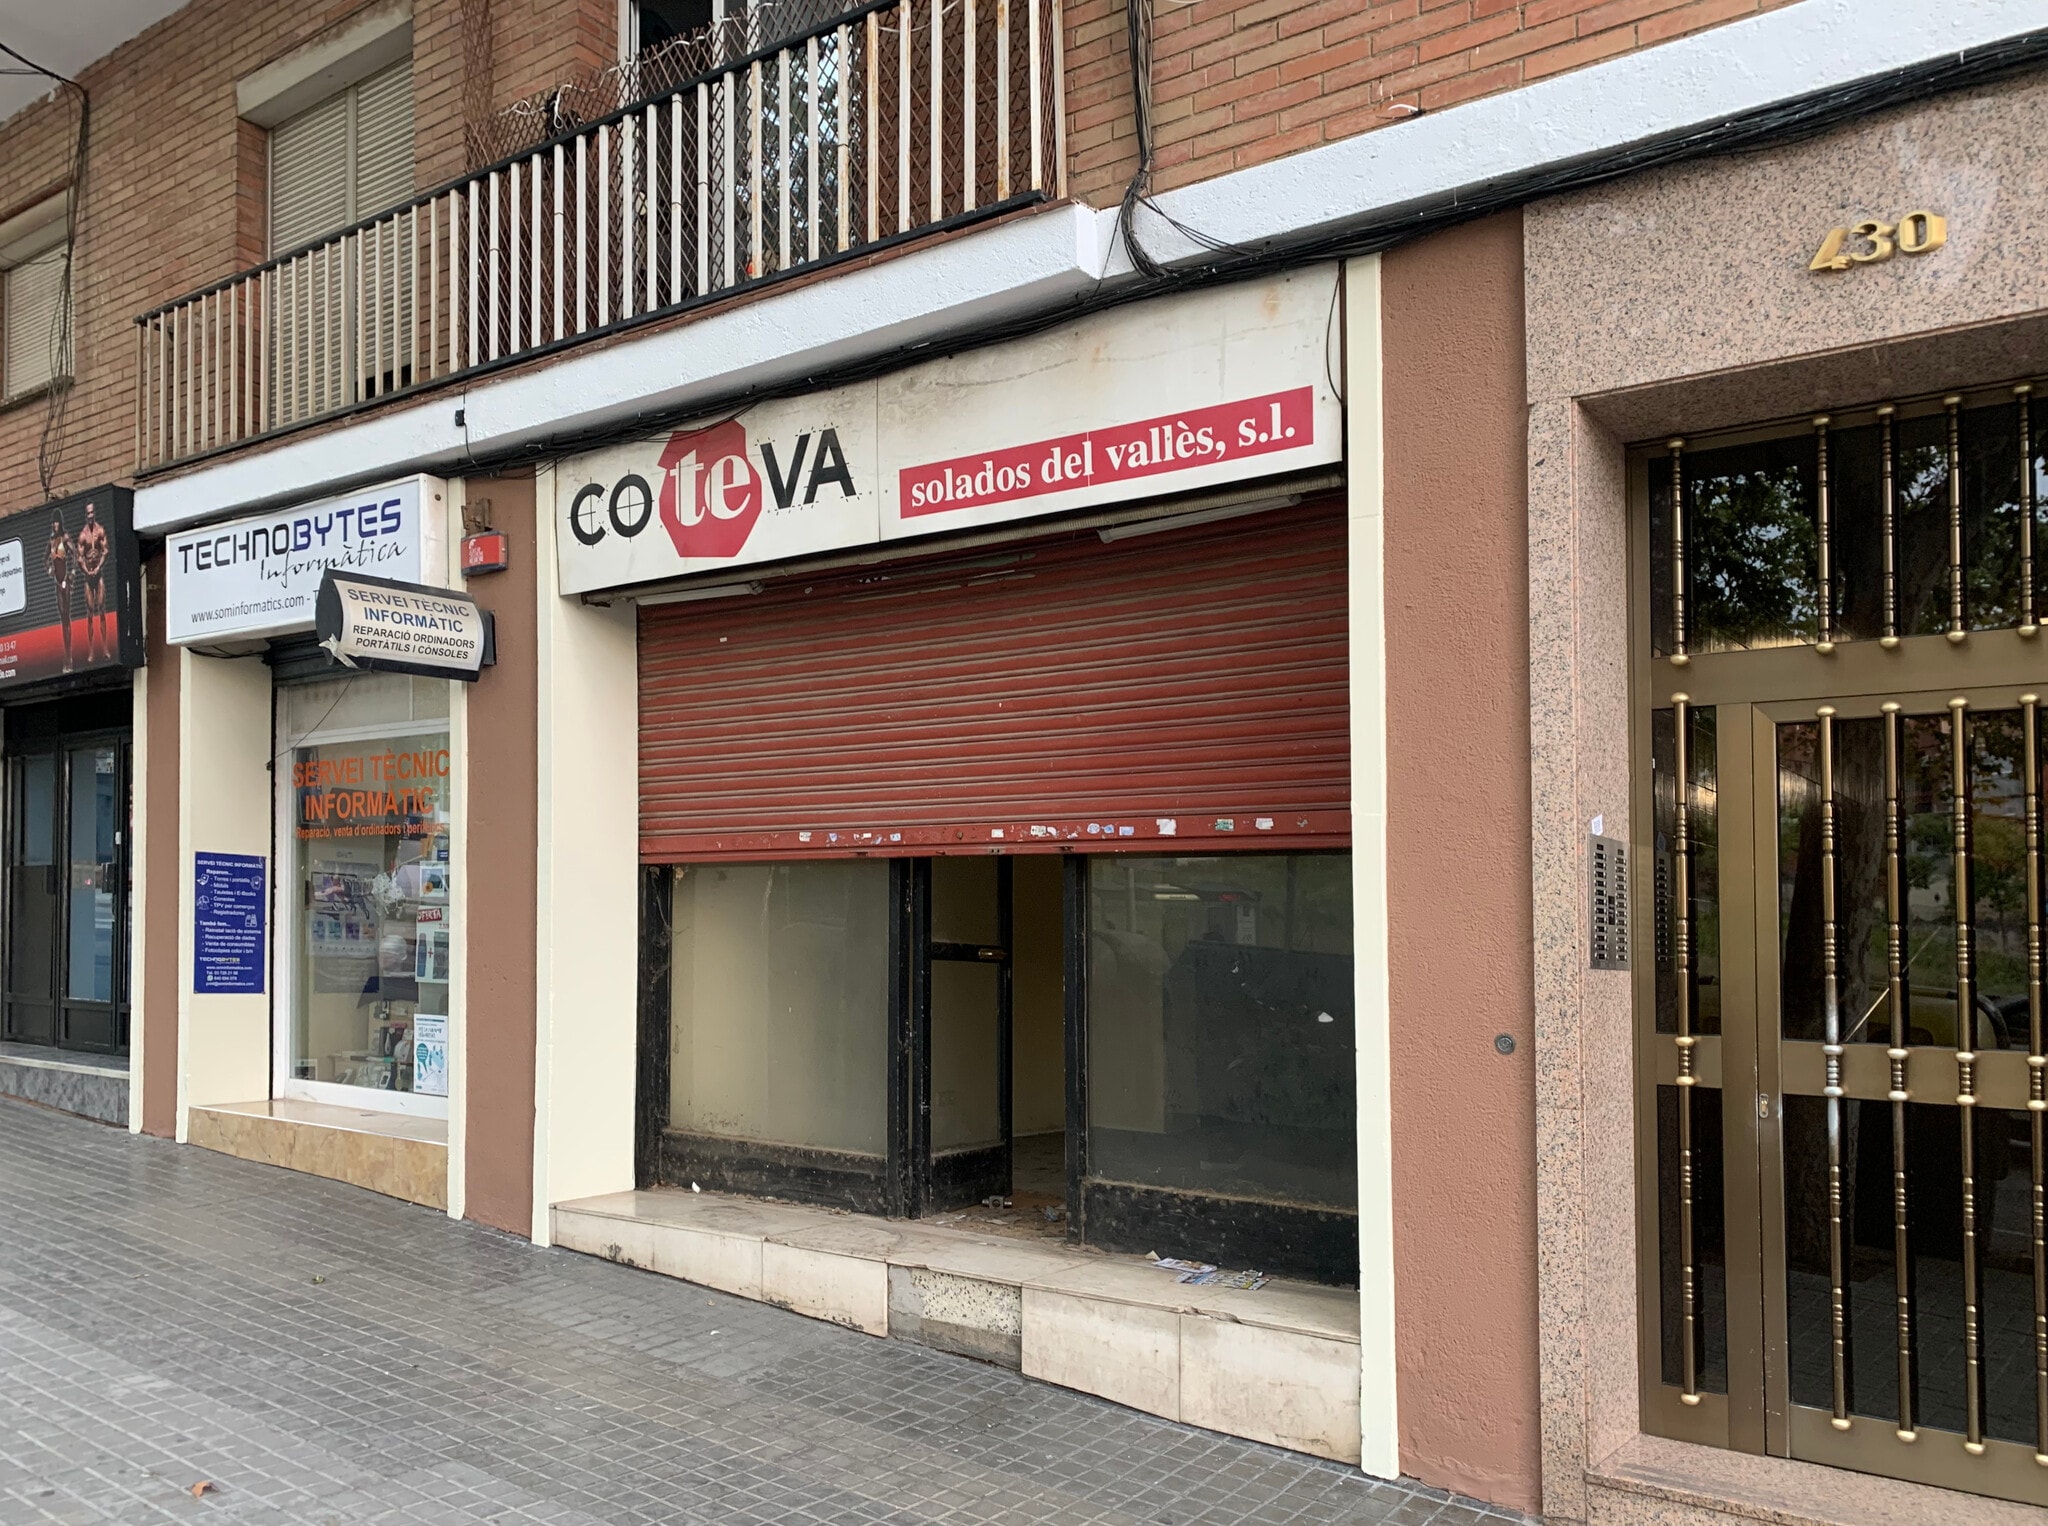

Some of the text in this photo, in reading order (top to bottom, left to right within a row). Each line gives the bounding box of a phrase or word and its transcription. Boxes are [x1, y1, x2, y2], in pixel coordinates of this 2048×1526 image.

[1809, 210, 1947, 271] 430
[911, 402, 1297, 507] solados del vallès, s.l.
[178, 498, 402, 574] TECHNOBYTES
[260, 538, 408, 589] Informàtica
[191, 594, 305, 623] www.sominformatics.com
[347, 589, 470, 617] SERVEI TÈCNIC
[364, 607, 464, 633] INFORMÀTIC
[353, 625, 475, 649] REPARACIÓ ORDINADORS
[356, 637, 410, 653] PORTÀTILS
[418, 644, 469, 660] CÒNSOLES
[293, 748, 450, 788] SERVEI TÈCNIC
[305, 784, 434, 820] INFORMÀTIC
[334, 825, 353, 837] venta
